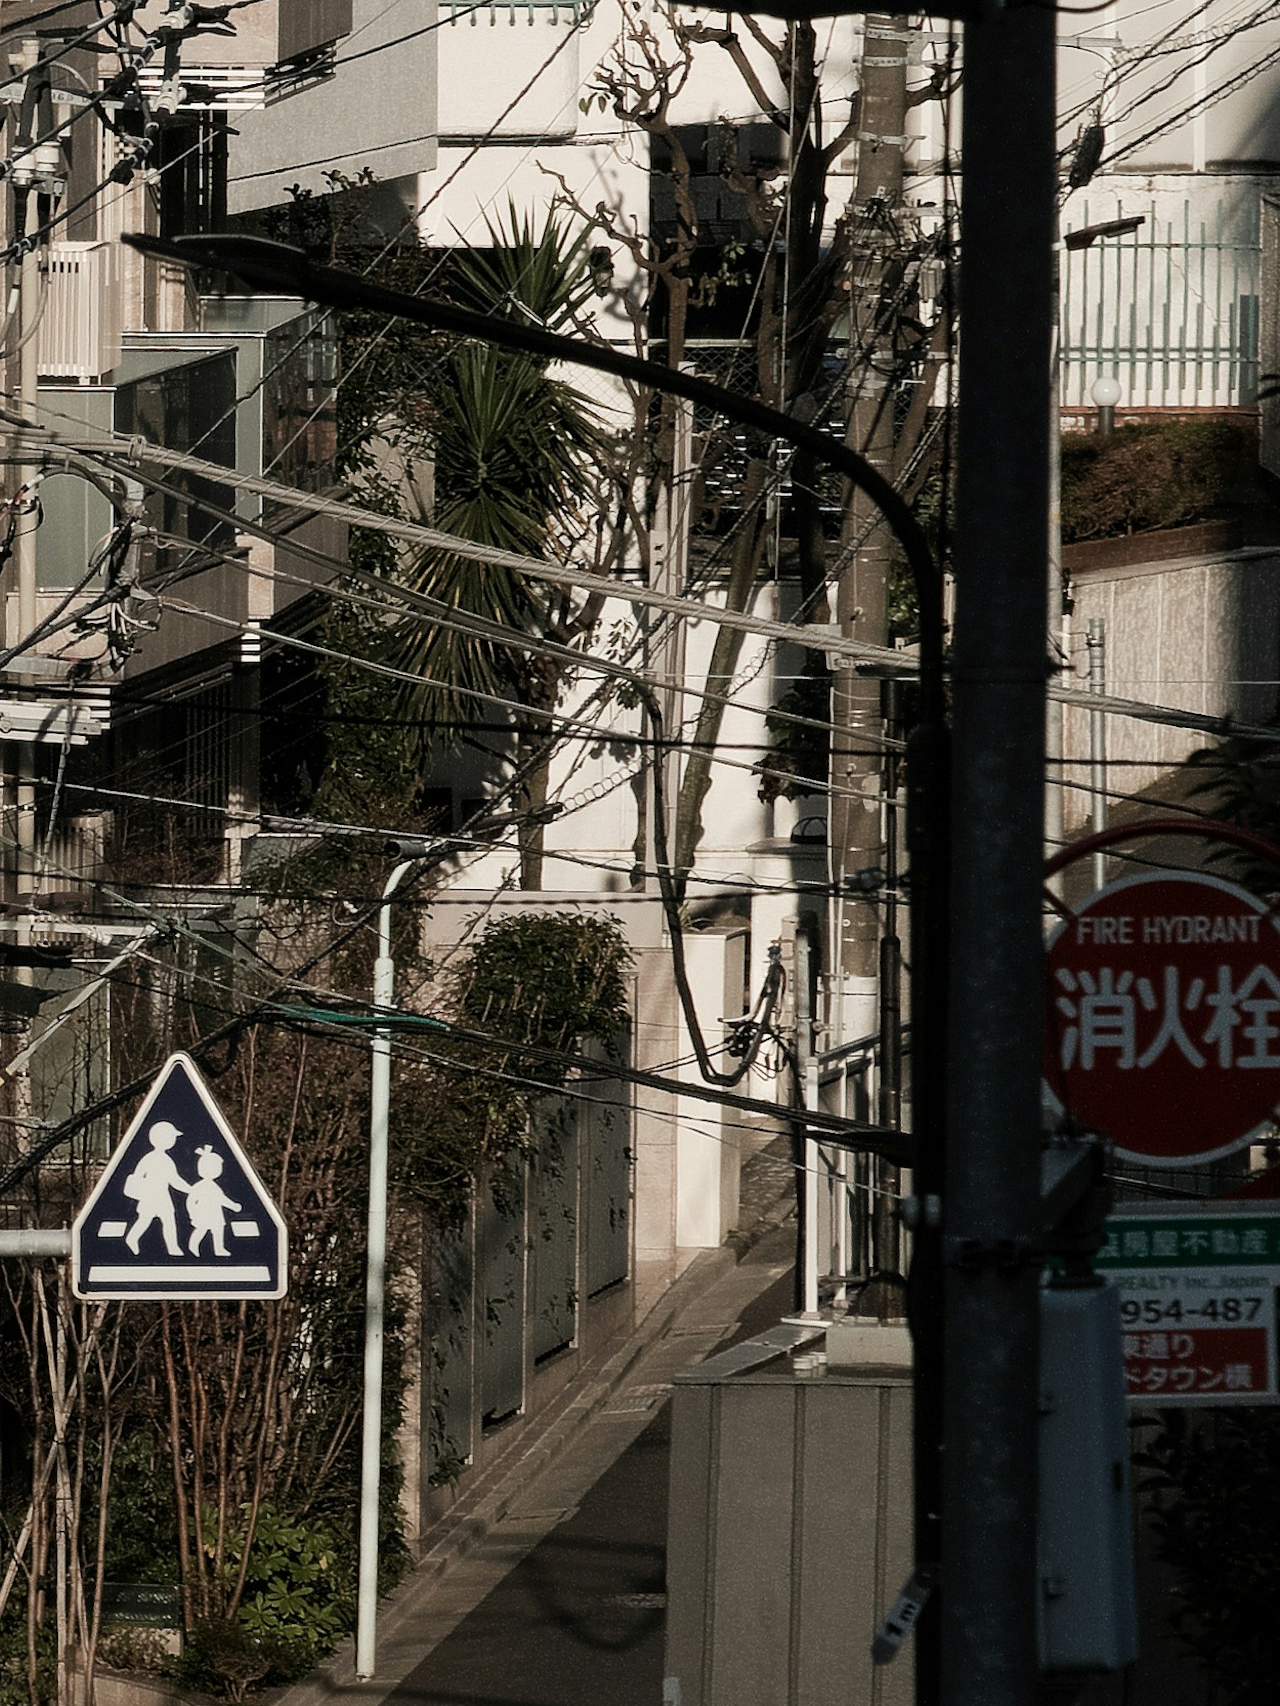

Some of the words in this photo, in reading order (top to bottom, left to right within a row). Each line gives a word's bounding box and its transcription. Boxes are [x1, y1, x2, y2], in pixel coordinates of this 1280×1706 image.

[1076, 915, 1135, 945] FIRE
[1142, 914, 1263, 944] HYDRANT
[1055, 964, 1280, 1071] 消火栓
